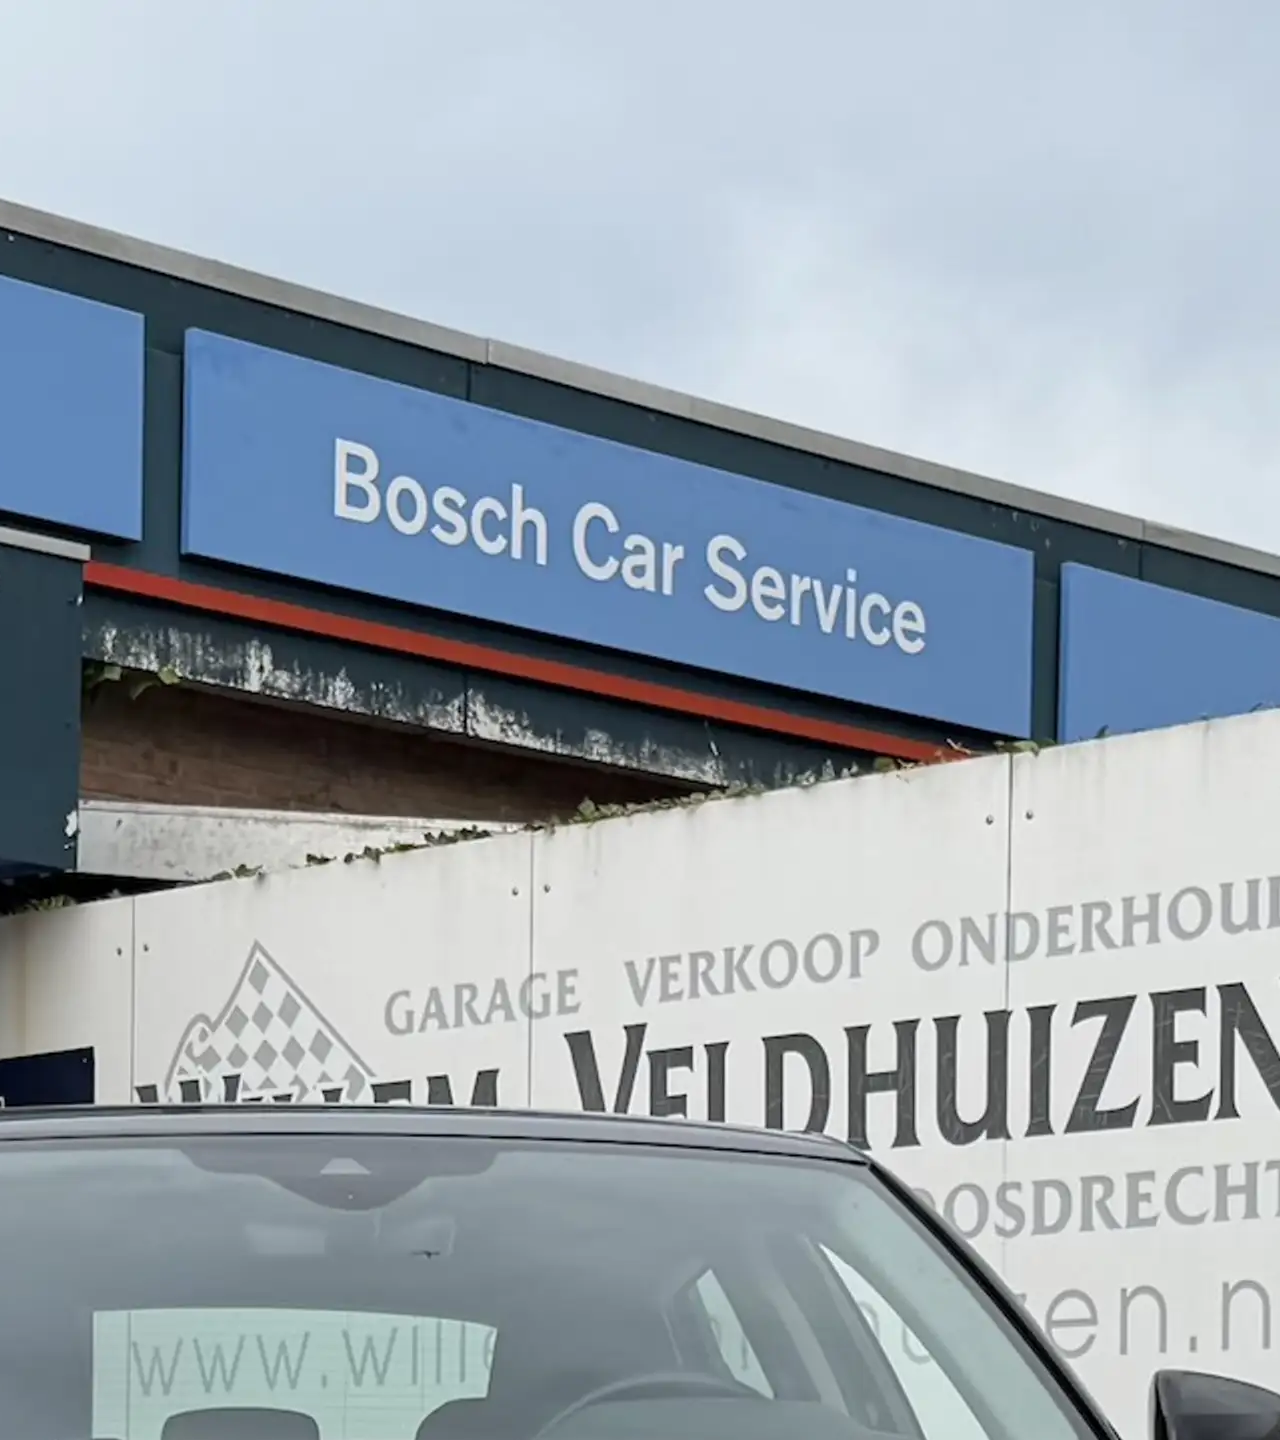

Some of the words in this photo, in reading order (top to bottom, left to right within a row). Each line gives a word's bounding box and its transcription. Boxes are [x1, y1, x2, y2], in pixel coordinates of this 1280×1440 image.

[334, 437, 548, 565] Bosch
[573, 501, 684, 596] Car
[704, 534, 927, 654] Service
[384, 968, 581, 1037] GARAGE
[623, 928, 880, 1007] VERKOOP
